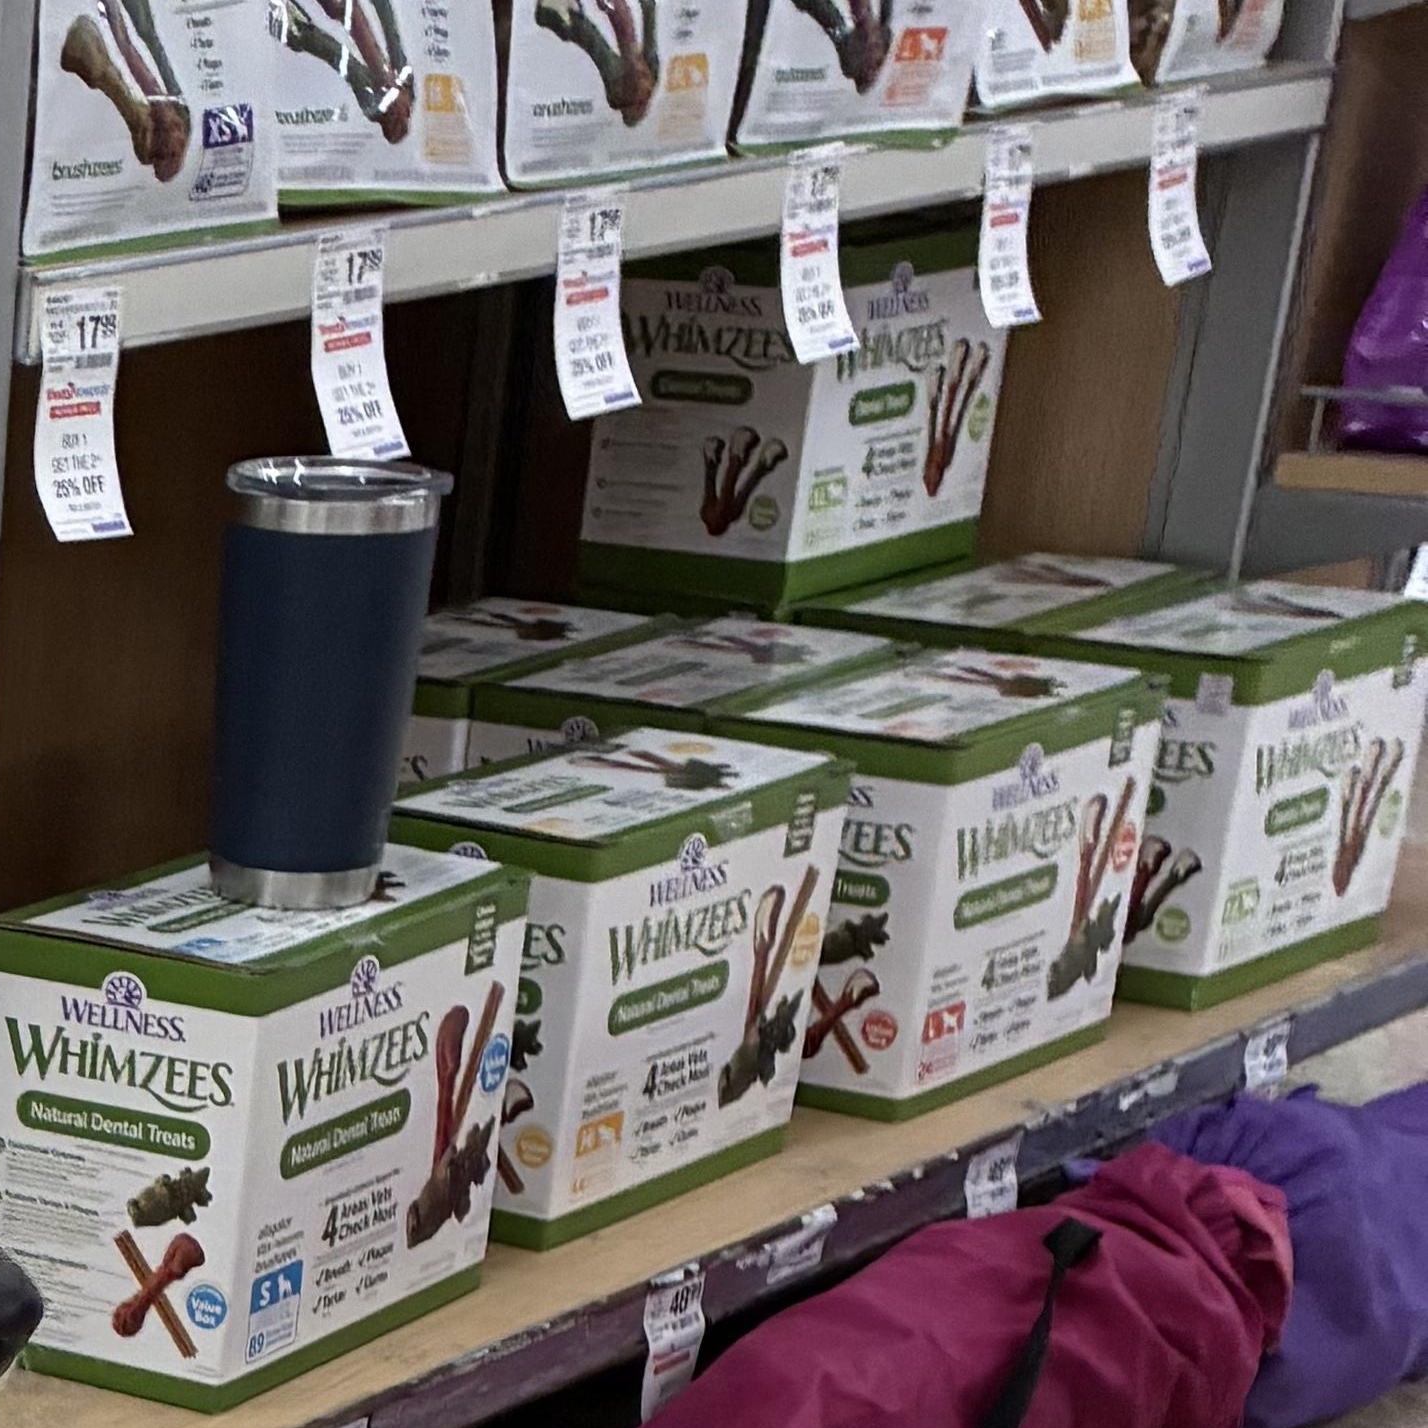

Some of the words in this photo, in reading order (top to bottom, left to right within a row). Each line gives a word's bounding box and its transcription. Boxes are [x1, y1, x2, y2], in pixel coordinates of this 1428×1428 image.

[83, 474, 106, 494] OFF
[650, 860, 730, 908] WELLNESS
[609, 888, 752, 987] WHIMZEES
[61, 996, 186, 1043] WELLNESS
[320, 981, 404, 1039] WELLNESS
[5, 1016, 235, 1112] WHIMZEES
[277, 1010, 431, 1127] WHIMZEES
[643, 1061, 658, 1100] 4
[31, 1101, 89, 1129] Natural
[91, 1113, 143, 1139] Dental
[147, 1123, 196, 1150] Treats
[290, 1133, 331, 1167] Natural
[332, 1118, 368, 1148] Dental
[368, 1106, 401, 1135] Treats
[321, 1205, 339, 1248] 4
[340, 1199, 368, 1219] Areas
[371, 1187, 393, 1207] Vets
[339, 1215, 370, 1241] Check
[372, 1201, 398, 1227] Most
[191, 1297, 222, 1316] Value
[259, 1280, 271, 1307] S
[194, 1312, 217, 1328] Box
